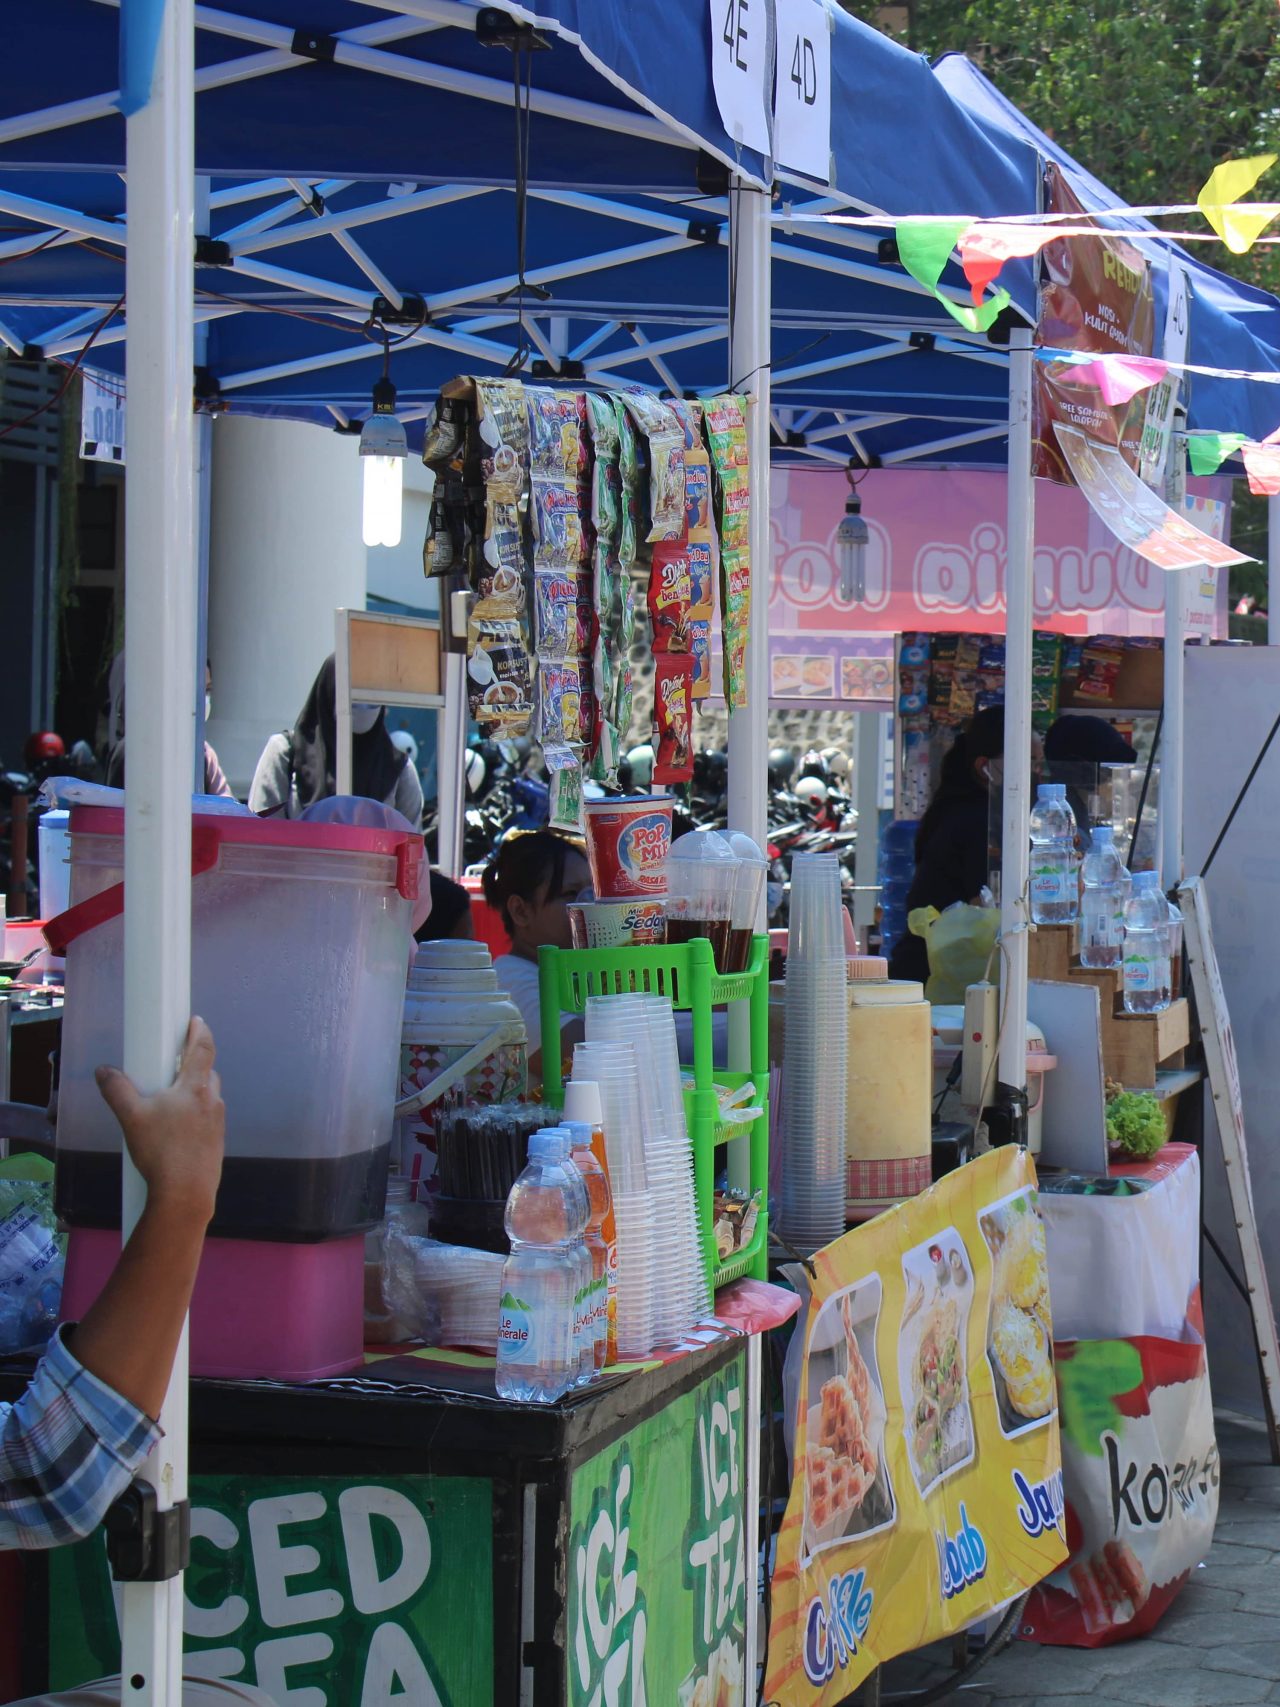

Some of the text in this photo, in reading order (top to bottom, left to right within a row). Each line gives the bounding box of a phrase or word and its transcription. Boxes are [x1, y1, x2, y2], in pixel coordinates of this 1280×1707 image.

[723, 0, 748, 72] 4E
[791, 34, 817, 106] 4D
[632, 823, 665, 849] POP
[502, 1316, 511, 1328] Le
[699, 1387, 741, 1520] ICE
[104, 1485, 432, 1640] CED
[575, 1463, 638, 1692] ICE
